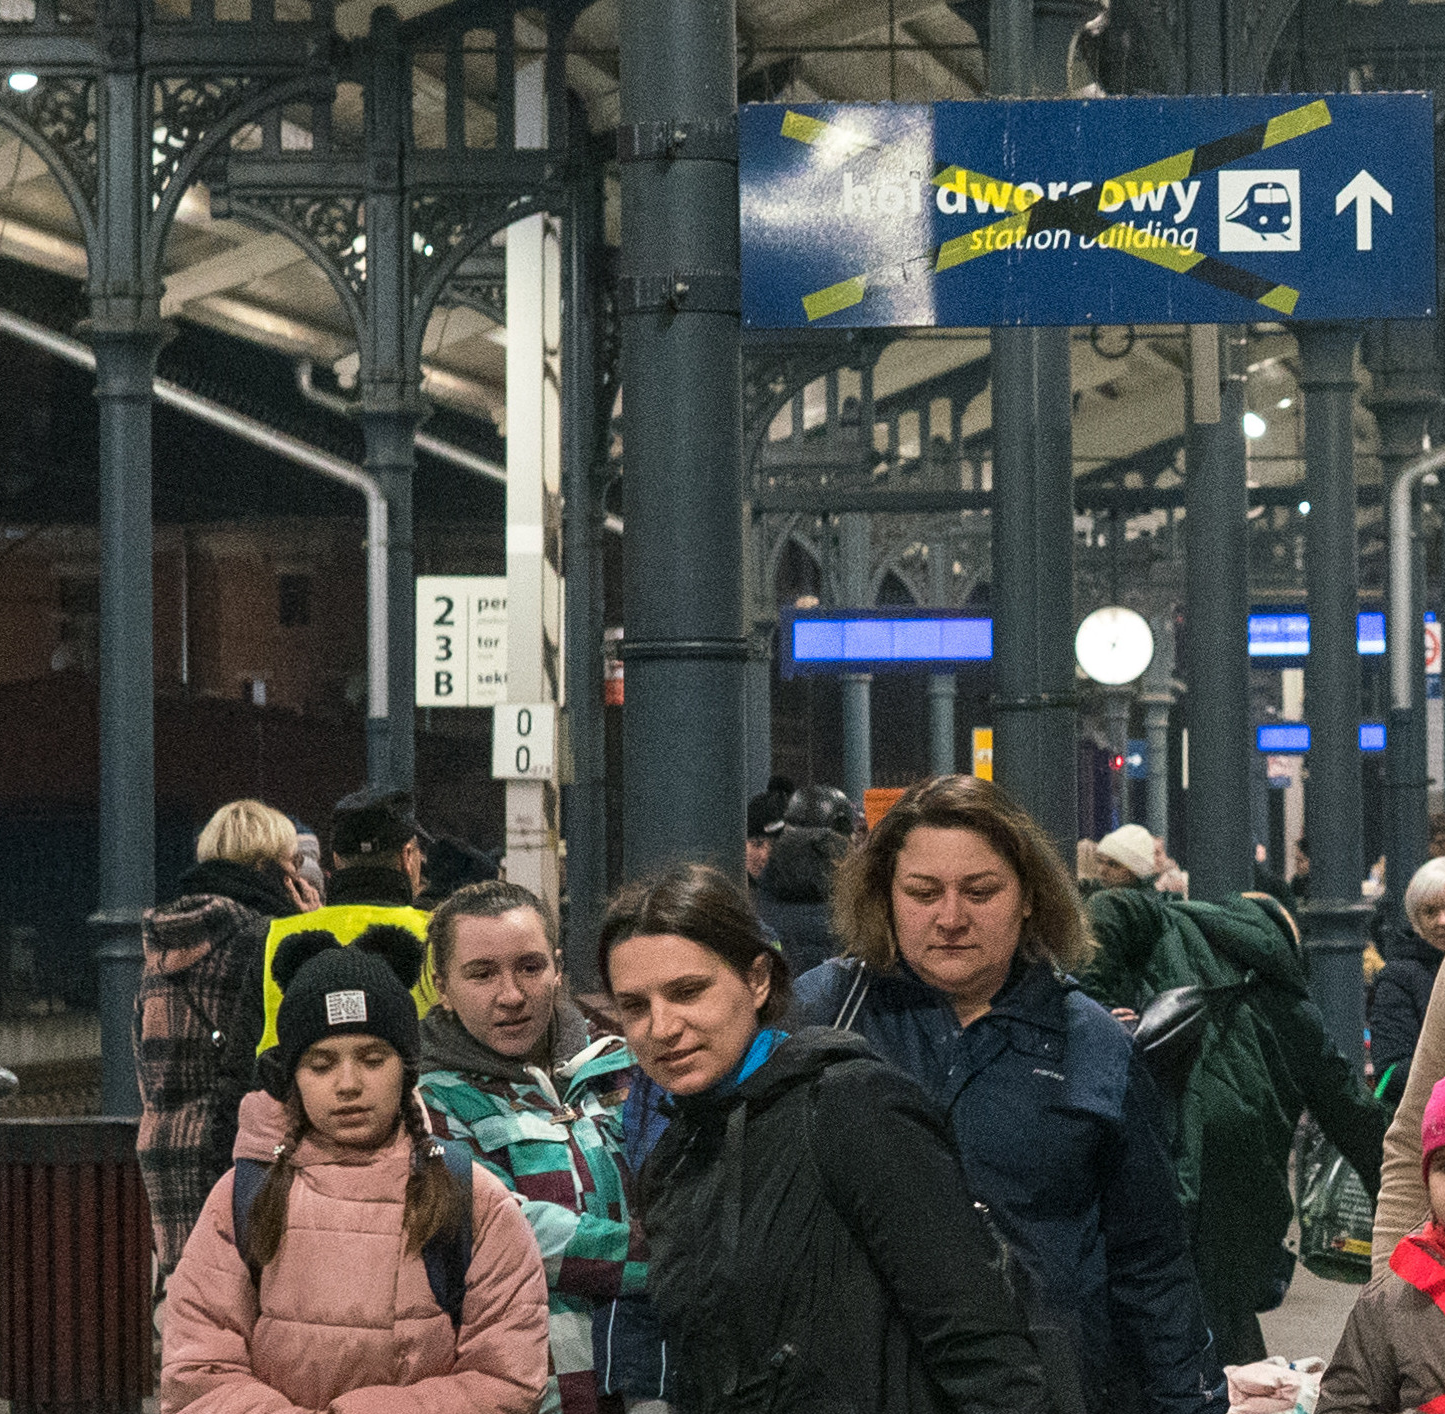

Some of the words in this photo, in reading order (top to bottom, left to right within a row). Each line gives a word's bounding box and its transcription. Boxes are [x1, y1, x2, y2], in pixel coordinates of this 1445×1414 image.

[970, 223, 1071, 250] station
[433, 596, 455, 626] 2
[478, 598, 507, 614] per
[434, 635, 453, 662] 3
[478, 636, 499, 649] tor
[434, 670, 454, 697] B
[477, 670, 508, 684] sekt
[517, 708, 532, 736] 0
[516, 745, 530, 773] 0
